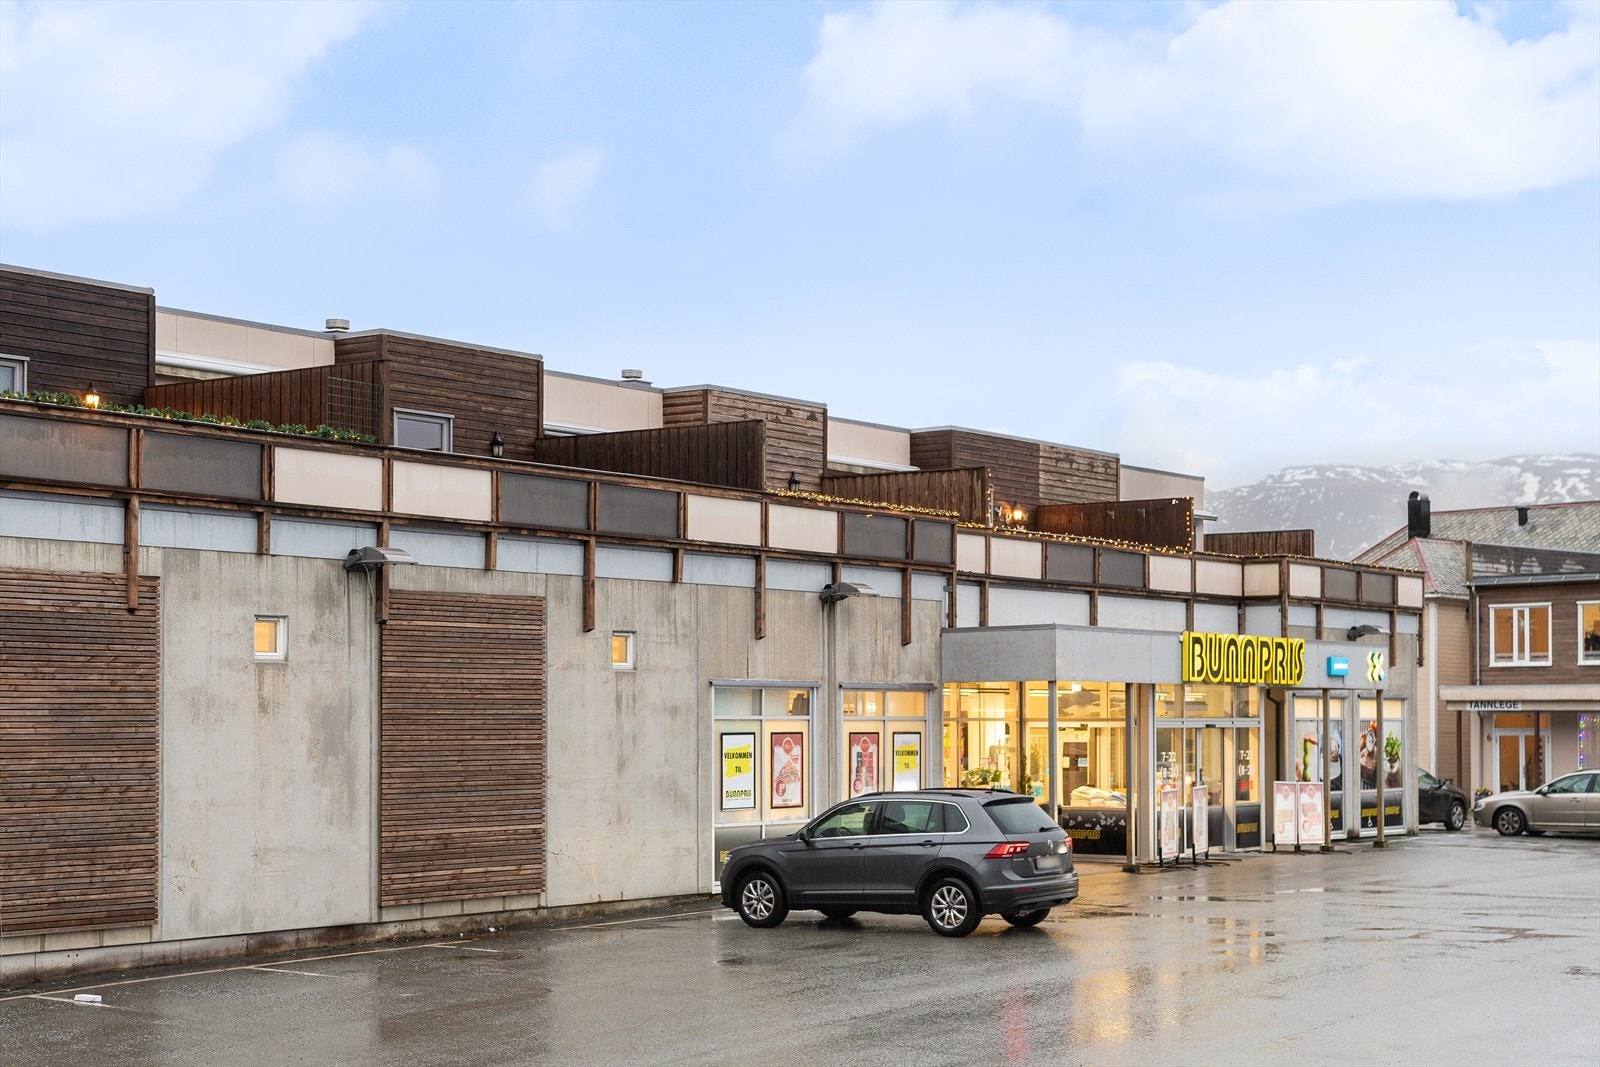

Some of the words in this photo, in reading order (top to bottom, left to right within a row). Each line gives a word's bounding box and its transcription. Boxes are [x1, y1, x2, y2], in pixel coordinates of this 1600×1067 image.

[1188, 632, 1305, 685] BUNNPRIS
[1469, 701, 1519, 709] TANNLEGE
[1486, 733, 1493, 742] 6
